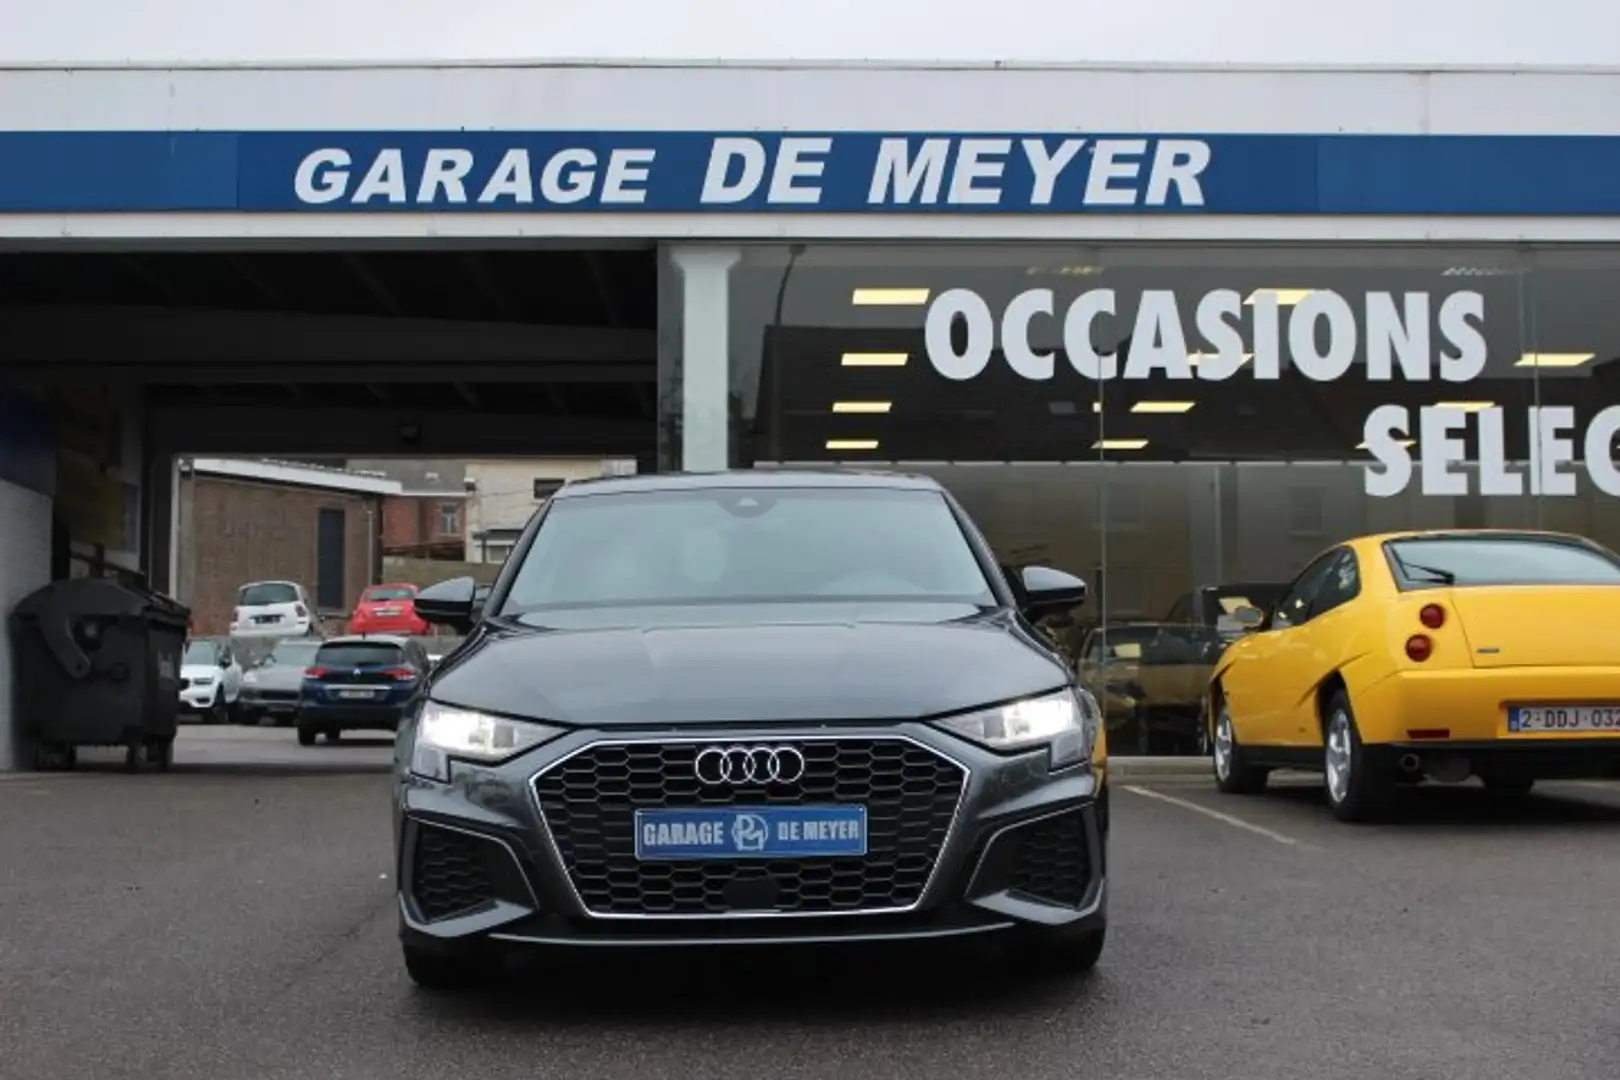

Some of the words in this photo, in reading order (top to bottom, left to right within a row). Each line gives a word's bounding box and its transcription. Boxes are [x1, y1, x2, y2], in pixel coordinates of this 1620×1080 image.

[294, 148, 656, 205] GARAGE
[700, 137, 833, 204] DE
[867, 138, 1212, 206] MEYER
[924, 288, 1487, 382] OCCASIONS
[643, 822, 724, 845] GARAGE
[778, 821, 800, 840] DE
[803, 820, 859, 840] MEYER
